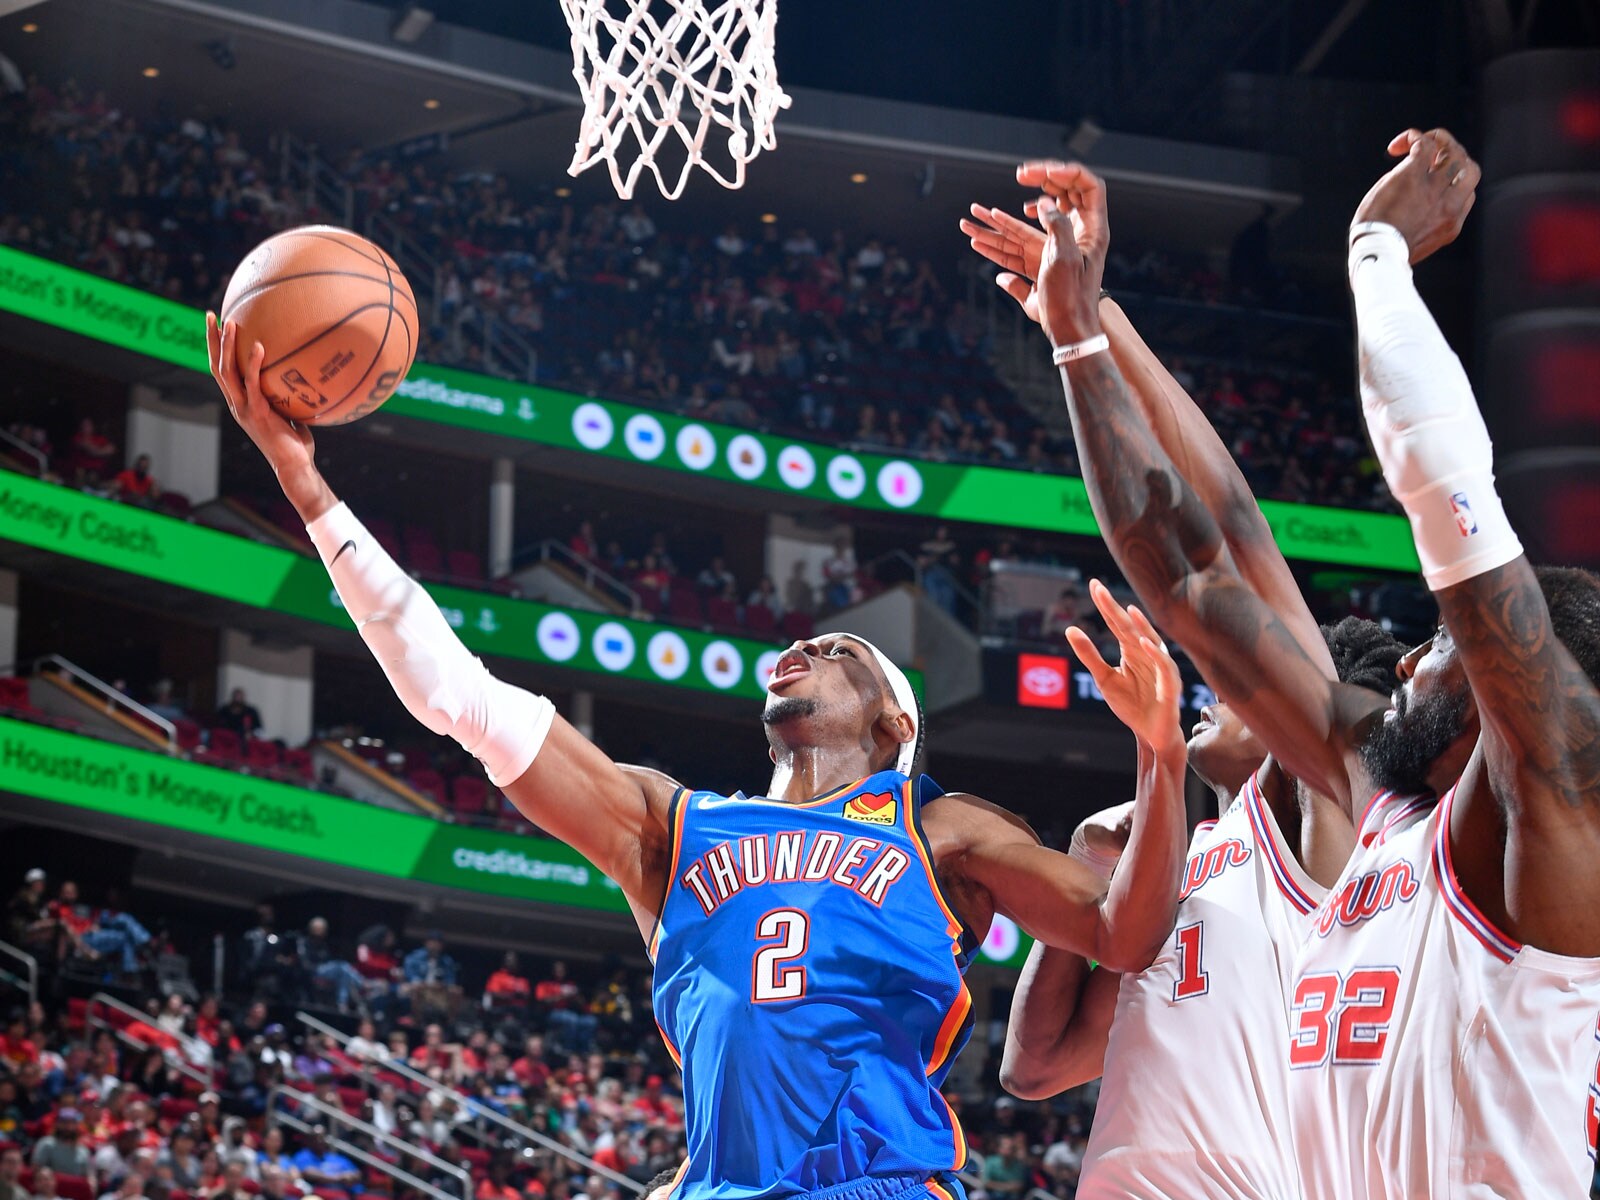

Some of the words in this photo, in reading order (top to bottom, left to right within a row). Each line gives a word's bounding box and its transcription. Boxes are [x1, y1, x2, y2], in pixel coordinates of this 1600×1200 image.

[3, 736, 139, 796] Houston's
[148, 769, 234, 824] Money
[681, 830, 911, 917] THUNDER
[751, 906, 811, 1004] 2
[1173, 920, 1209, 1002] 1
[1289, 965, 1402, 1070] 32
